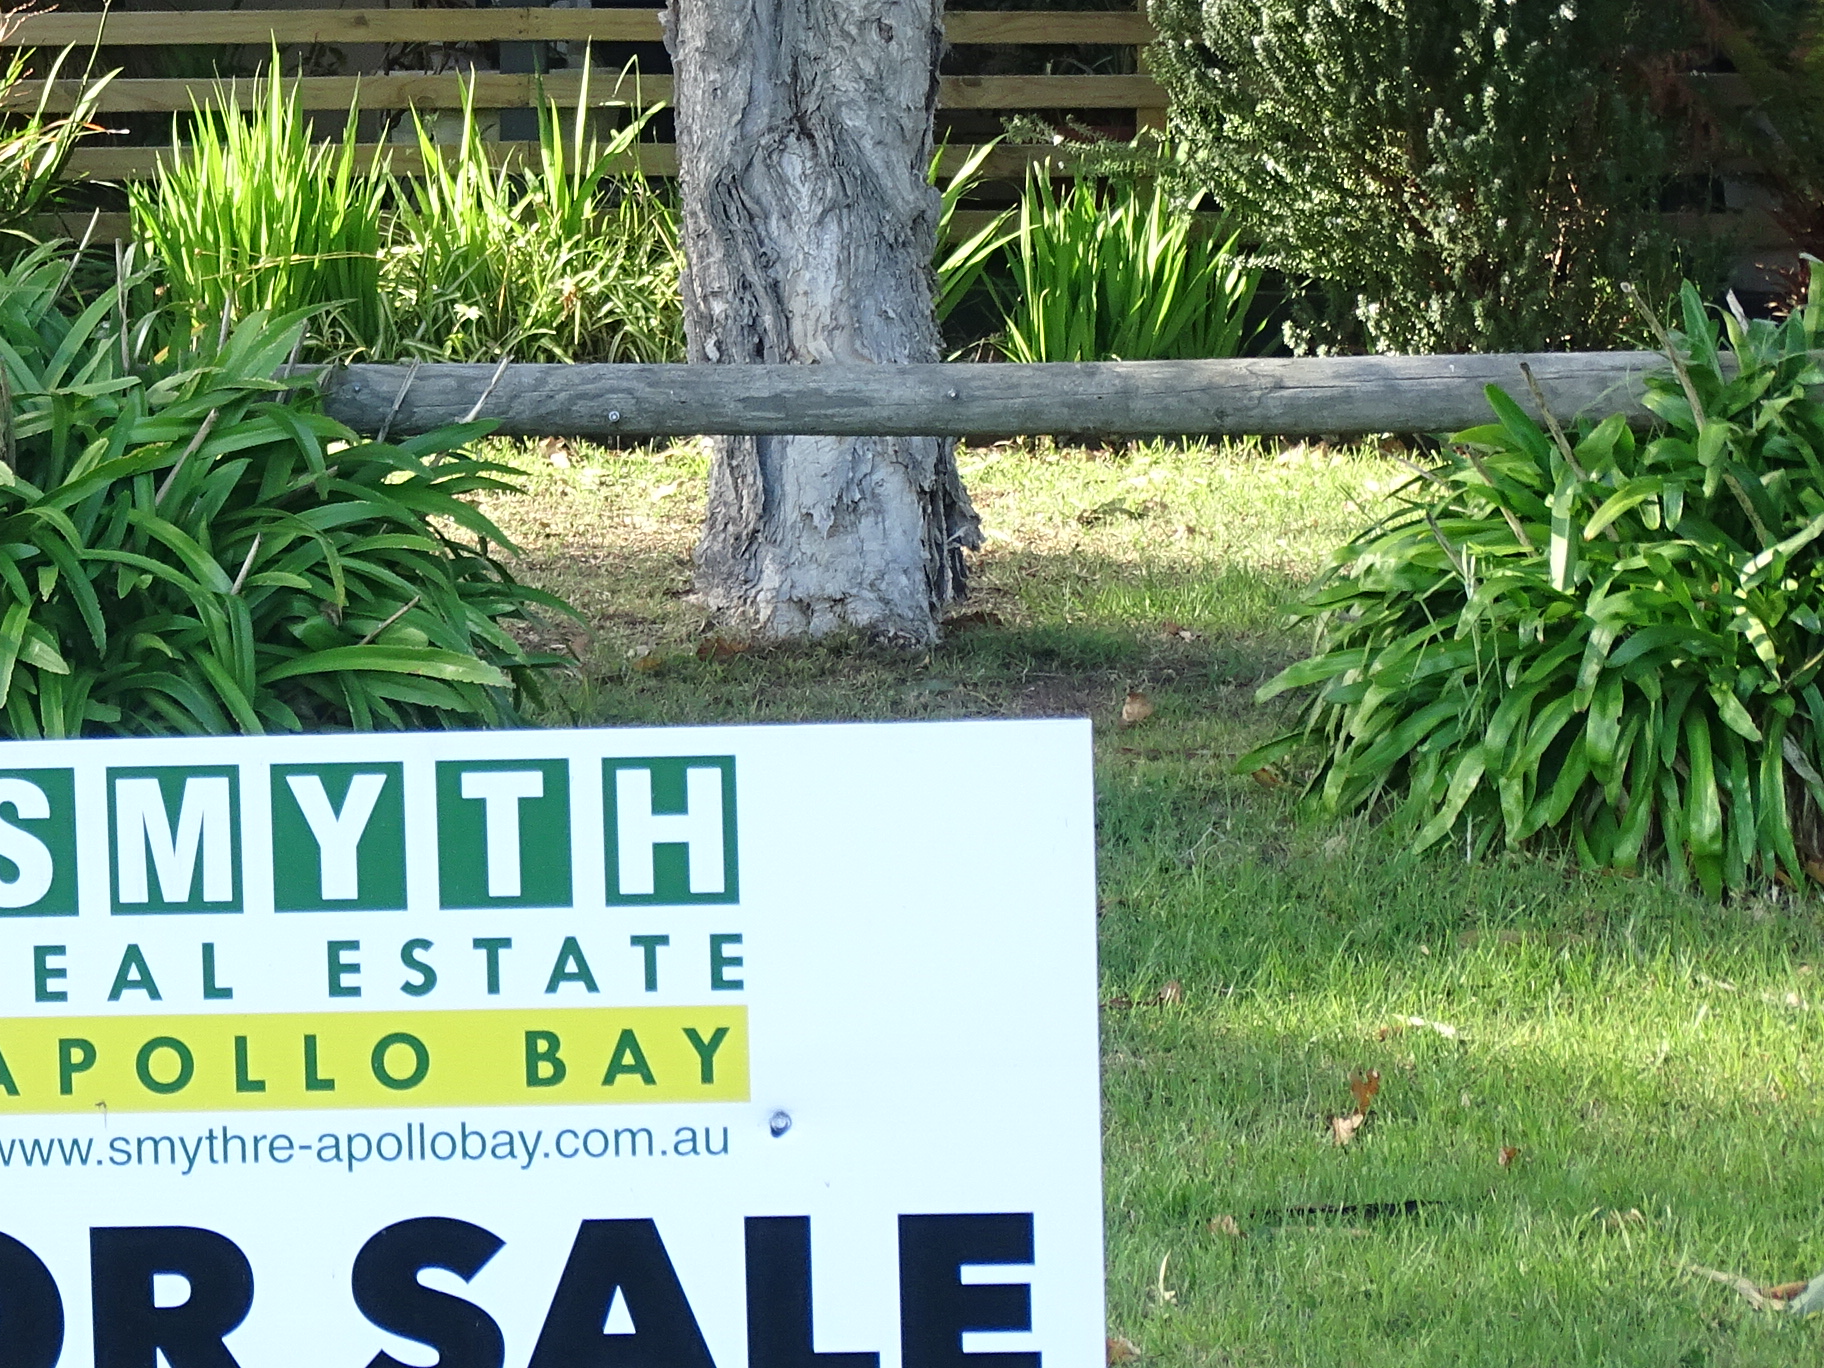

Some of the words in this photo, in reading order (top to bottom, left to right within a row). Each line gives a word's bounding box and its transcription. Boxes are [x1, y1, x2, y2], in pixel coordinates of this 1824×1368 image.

[326, 932, 746, 998] ESTATE
[524, 1025, 731, 1089] BAY
[351, 1212, 1037, 1368] SALE
